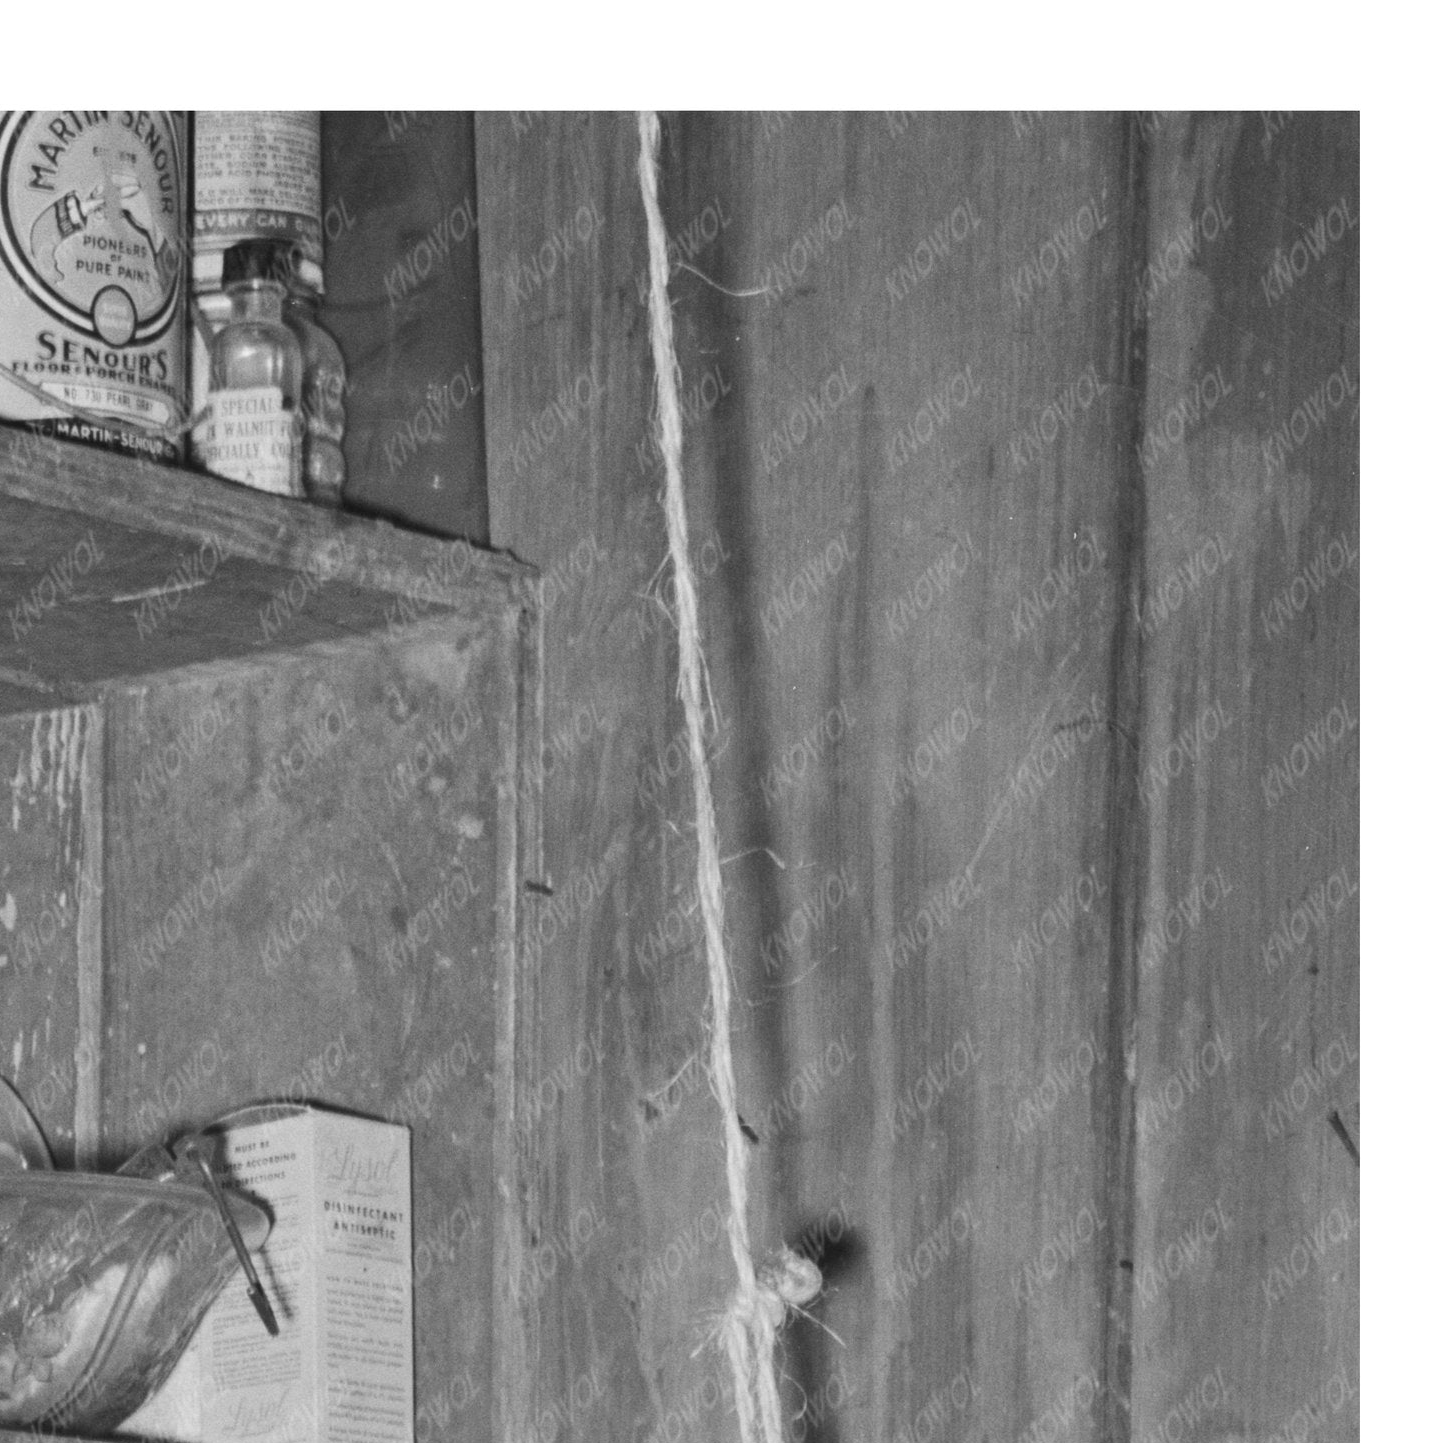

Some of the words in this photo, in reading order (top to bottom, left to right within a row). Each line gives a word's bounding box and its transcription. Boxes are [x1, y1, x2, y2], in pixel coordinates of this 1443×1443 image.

[28, 111, 108, 190] MARTIN
[76, 259, 112, 275] PURE
[36, 330, 168, 380] SENOUR'S
[223, 420, 275, 438] WALNUT
[329, 1144, 400, 1190] Lysol
[324, 1200, 405, 1222] DISINFECTANT
[333, 1221, 397, 1241] ANTISEPTIC
